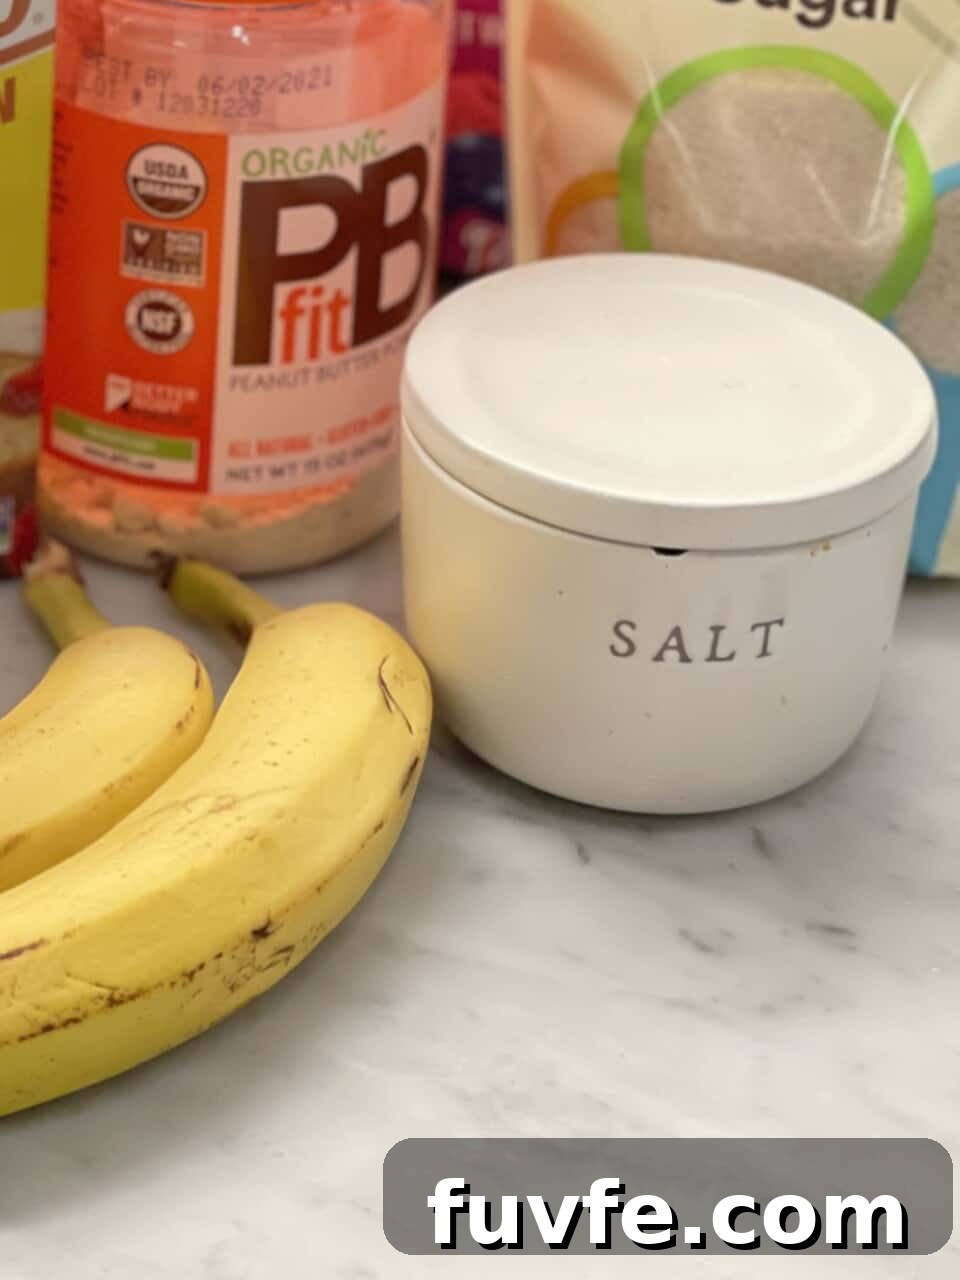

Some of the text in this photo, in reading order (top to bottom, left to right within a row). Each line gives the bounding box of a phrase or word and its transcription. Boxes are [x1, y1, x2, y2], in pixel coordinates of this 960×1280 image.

[144, 66, 171, 89] BY
[143, 159, 189, 180] USDA
[232, 143, 430, 366] PB
[277, 286, 352, 365] fit
[229, 367, 310, 392] PEANUT
[607, 617, 787, 665] SALT
